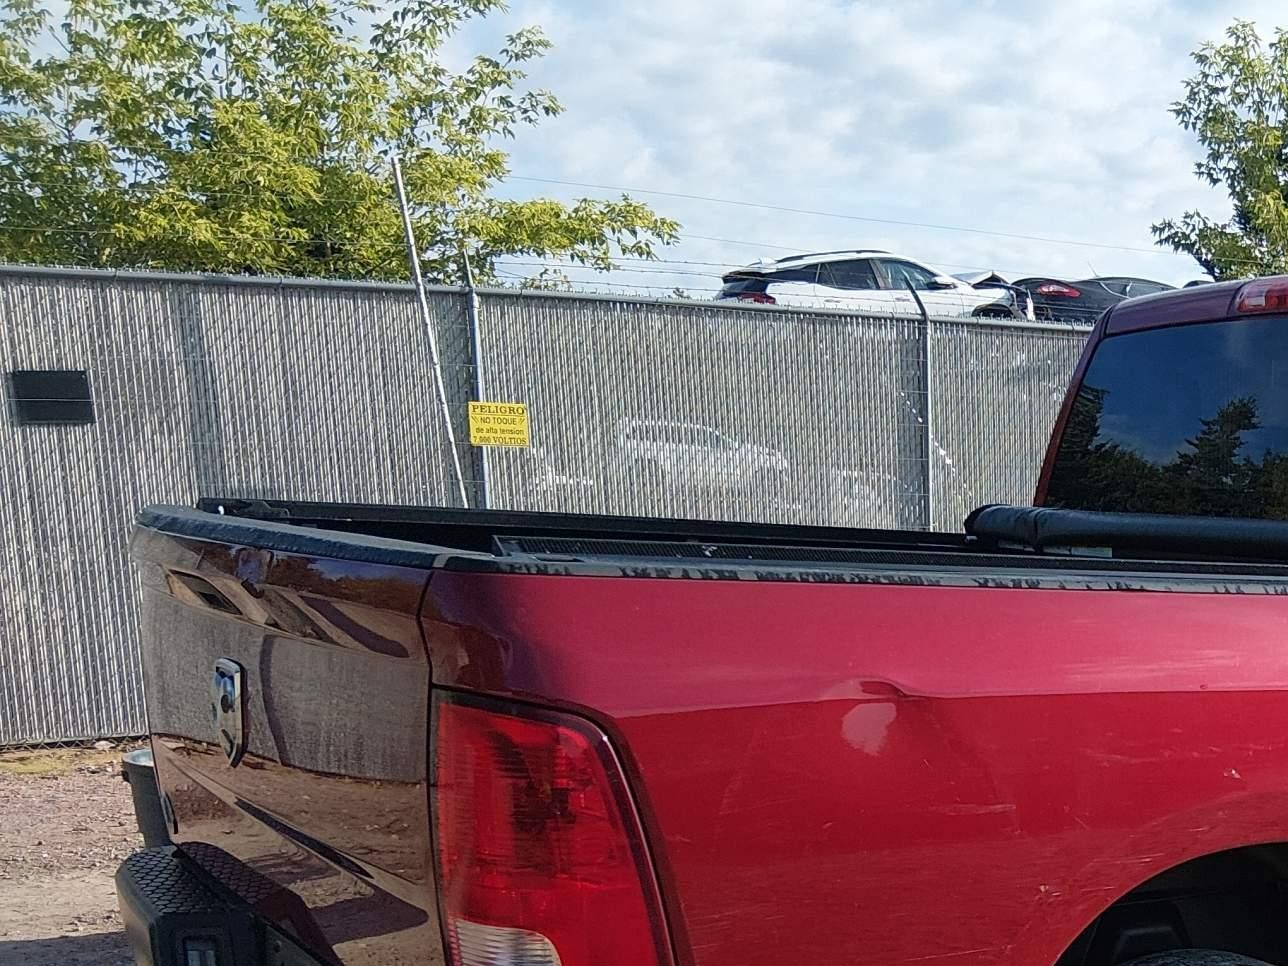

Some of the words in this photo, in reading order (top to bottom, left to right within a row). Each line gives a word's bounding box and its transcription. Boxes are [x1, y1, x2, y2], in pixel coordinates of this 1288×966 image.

[472, 405, 525, 415] PELIGRO
[493, 417, 517, 425] TOQUE
[486, 426, 498, 434] alta
[492, 436, 527, 444] VOLTIOS
